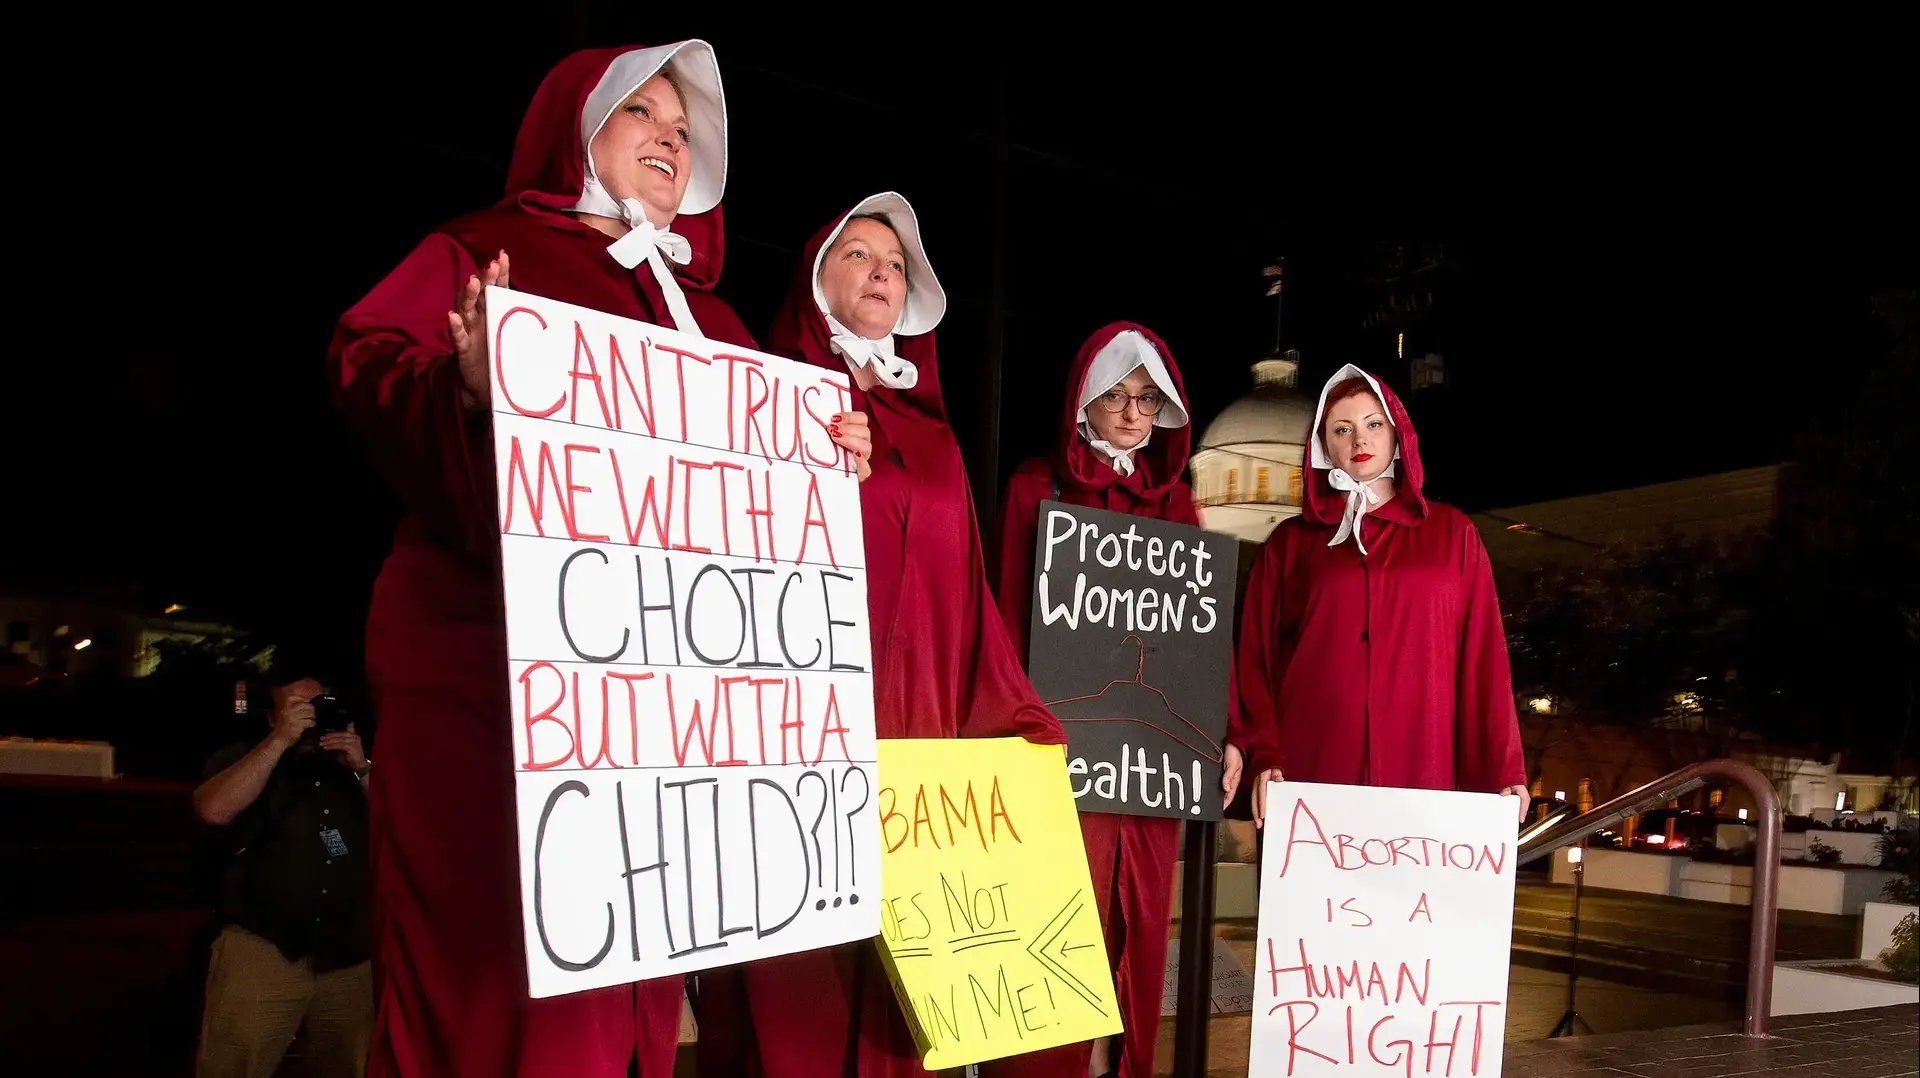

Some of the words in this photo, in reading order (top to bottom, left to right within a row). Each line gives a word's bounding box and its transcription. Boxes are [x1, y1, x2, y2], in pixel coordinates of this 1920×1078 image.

[495, 306, 711, 443] CAN'T
[713, 353, 851, 477] TRUST
[503, 435, 611, 542] ME
[609, 447, 778, 564] WITH
[794, 472, 840, 571] A
[1044, 510, 1213, 588] Protect
[558, 547, 865, 672] CHOICE
[518, 661, 654, 770] BUT
[666, 673, 807, 767] WITH
[811, 683, 855, 768] A
[878, 775, 1022, 854] BAMA
[1067, 743, 1202, 815] ealth!
[534, 766, 870, 973] CHILD?!?
[1279, 797, 1506, 878] ABORTION
[880, 892, 932, 942] OES
[939, 870, 1009, 934] NOT
[1326, 897, 1373, 927] IS
[1408, 892, 1433, 923] A
[968, 963, 1061, 1040] ME!
[1267, 938, 1431, 1007] HUMAN
[1269, 1000, 1502, 1078] RIGHT
